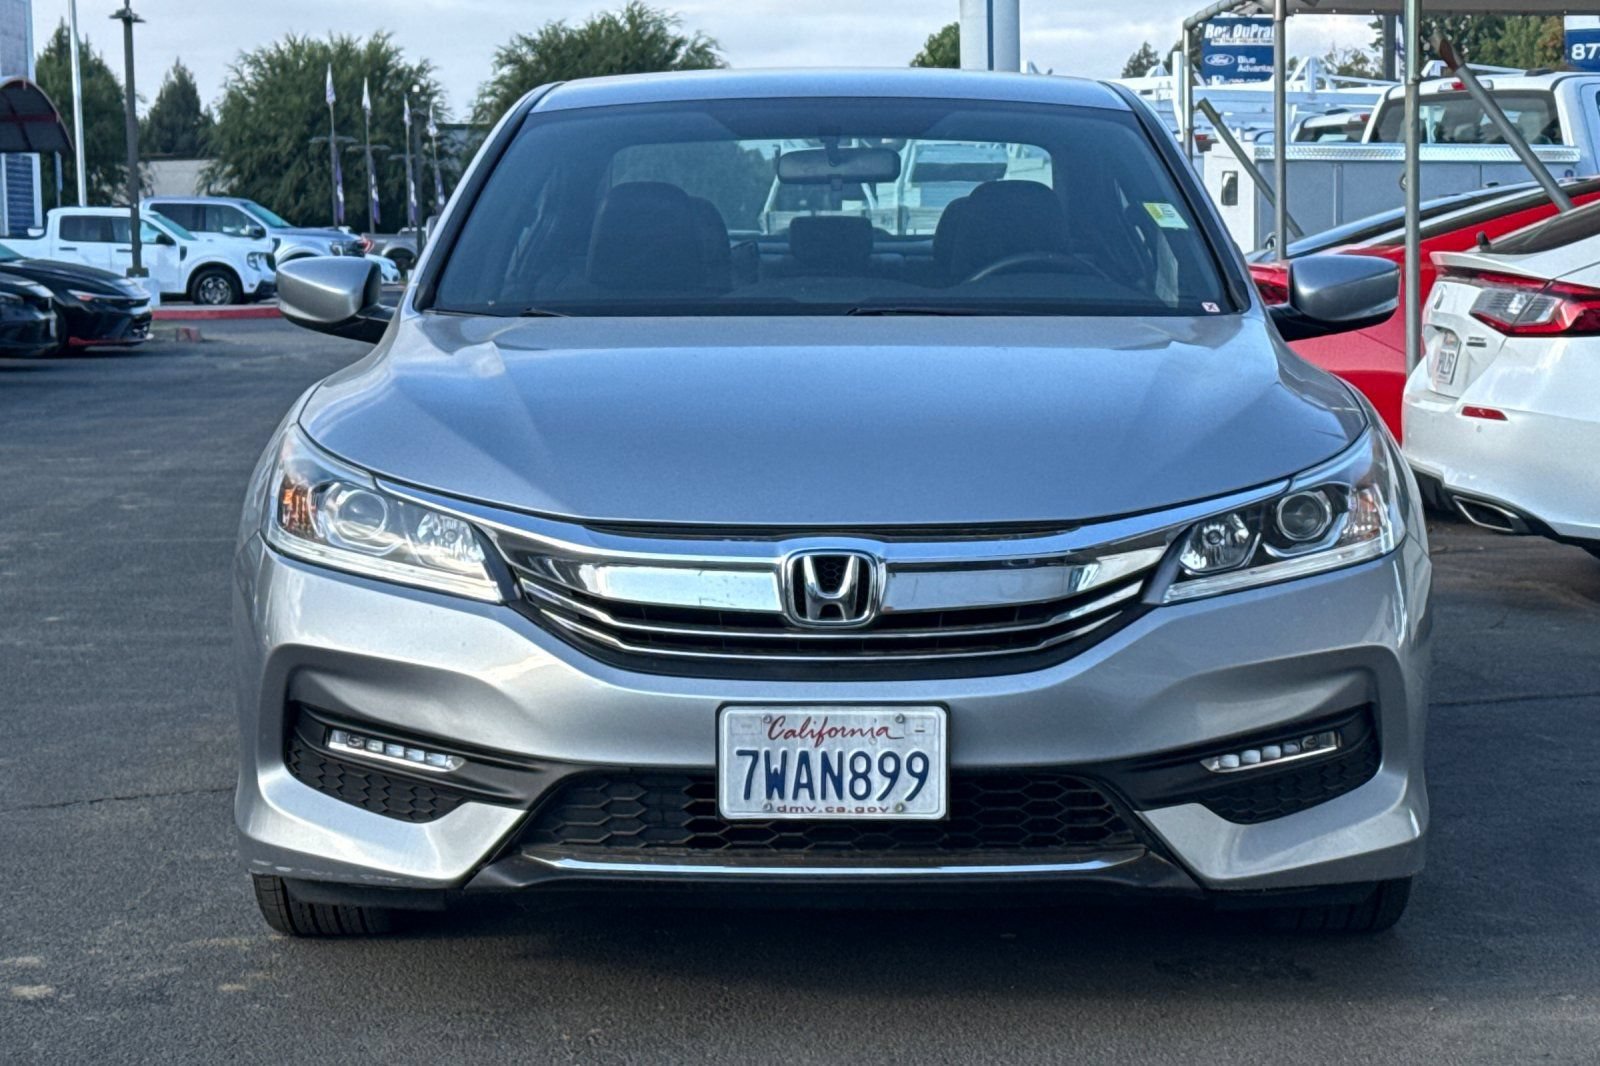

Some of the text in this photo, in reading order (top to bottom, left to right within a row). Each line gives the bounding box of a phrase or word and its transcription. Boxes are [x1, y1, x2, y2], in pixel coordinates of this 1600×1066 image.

[767, 715, 904, 748] California
[736, 749, 930, 801] 7WAN899
[777, 804, 889, 814] dmv.ca.gov
